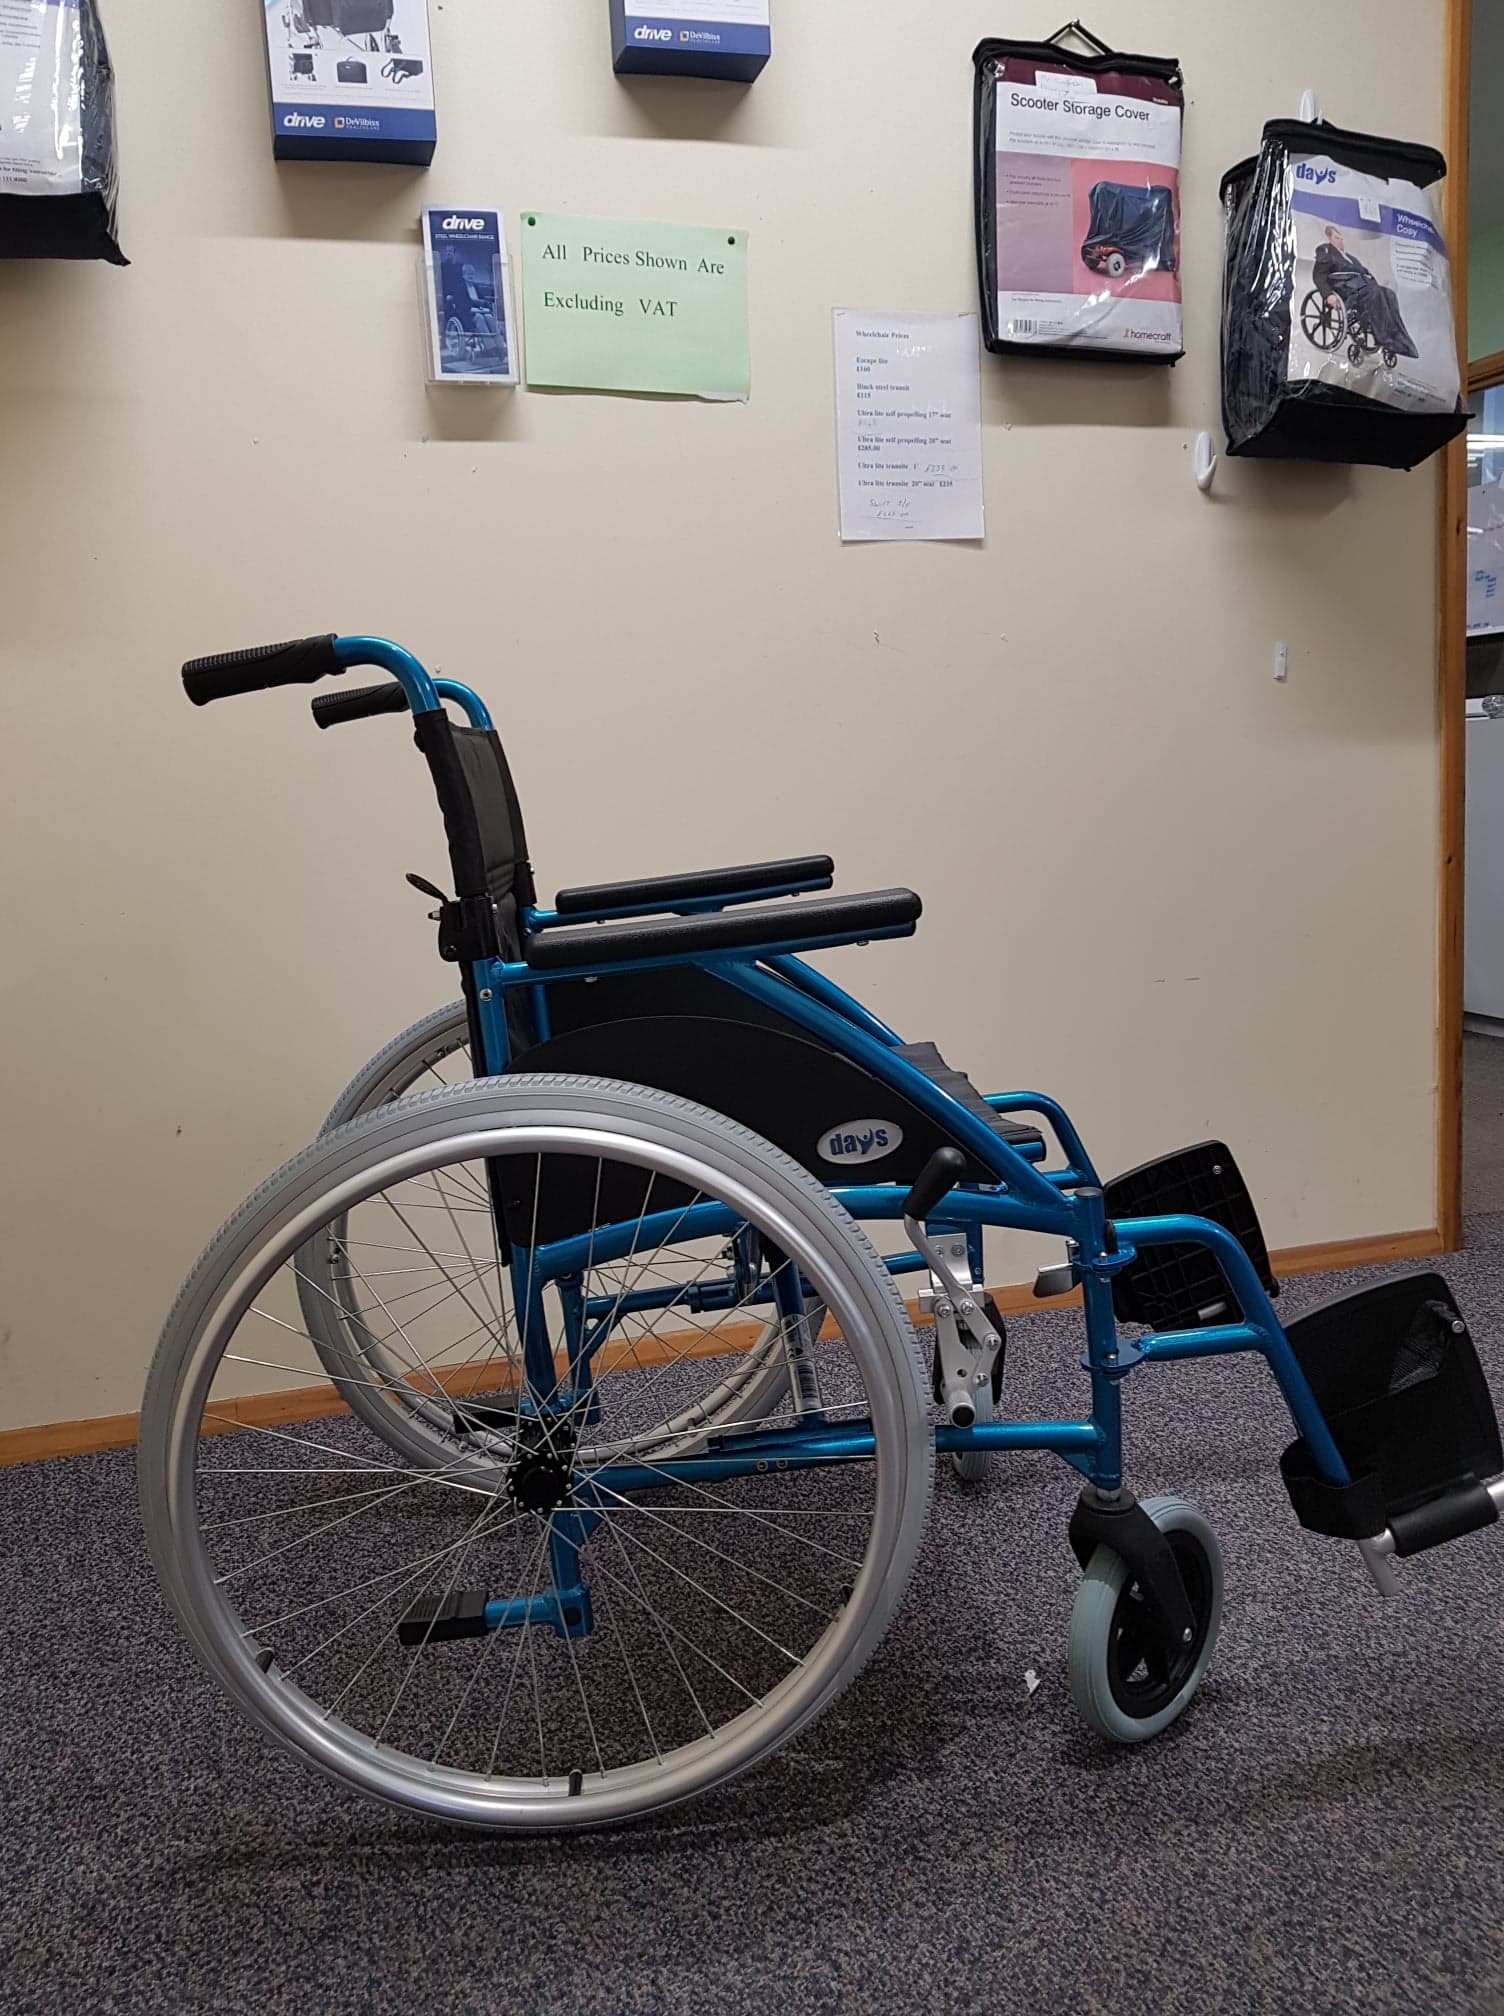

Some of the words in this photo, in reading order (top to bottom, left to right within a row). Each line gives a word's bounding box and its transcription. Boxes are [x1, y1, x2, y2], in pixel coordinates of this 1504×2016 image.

[634, 25, 672, 41] drive
[1010, 93, 1059, 112] Scooter
[1063, 99, 1111, 119] Storage
[1114, 105, 1150, 121] Cover
[283, 111, 326, 128] drive
[1296, 163, 1337, 184] days
[442, 215, 485, 230] drive
[1396, 224, 1418, 238] Cosy
[542, 244, 567, 260] All
[582, 246, 630, 266] Prices
[635, 250, 688, 271] Shown
[696, 258, 725, 275] Are
[544, 292, 624, 317] Excluding
[639, 299, 678, 317] VAT
[1130, 328, 1172, 342] homecraft
[829, 1128, 889, 1156] days
